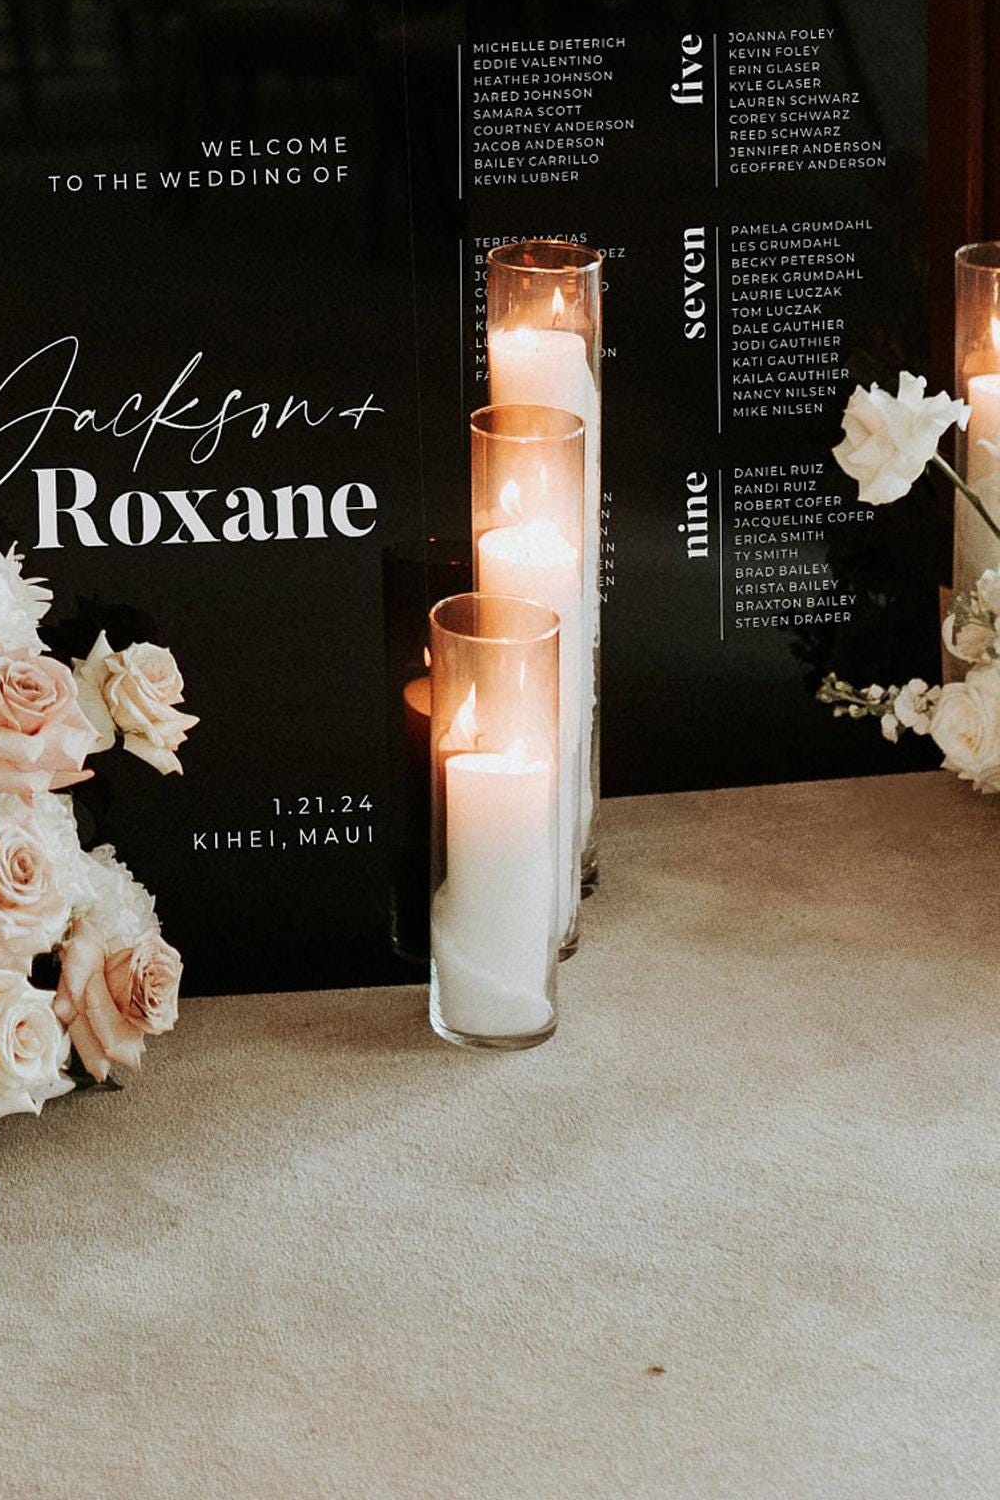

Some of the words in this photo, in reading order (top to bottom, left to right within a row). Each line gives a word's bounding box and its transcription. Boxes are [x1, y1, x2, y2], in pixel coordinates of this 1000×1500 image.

[473, 40, 545, 53] MICHELLE
[549, 37, 625, 51] DIETERICH
[473, 58, 517, 70] EDDIE
[521, 55, 603, 68] VALENTINO
[671, 34, 703, 104] five
[474, 74, 540, 86] HEATHER
[544, 71, 613, 84] JOHNSON
[473, 91, 520, 103] JARED
[523, 88, 592, 101] JOHNSON
[473, 107, 533, 120] SAMARA
[537, 104, 582, 117] SCOTT
[473, 123, 551, 136] COURTNEY
[554, 117, 634, 132] ANDERSON
[202, 137, 346, 157] WELCOME
[473, 140, 520, 153] JACOB
[525, 136, 604, 150] ANDERSON
[474, 157, 525, 170] BAILEY
[528, 153, 599, 167] CARRILLO
[48, 175, 82, 192] TO
[94, 173, 147, 190] THE
[160, 168, 300, 188] WEDDING
[314, 166, 347, 182] OF
[474, 174, 517, 185] KEVIN
[521, 171, 579, 184] LUBNER
[684, 227, 706, 339] seven
[734, 465, 787, 479] DANIEL
[790, 463, 824, 475] RUIZ
[734, 483, 779, 495] RANDI
[784, 480, 816, 492] RUIZ
[32, 468, 377, 549] Roxane
[734, 498, 791, 512] ROBERT
[795, 495, 842, 508] COFER
[678, 472, 708, 559] nine
[734, 513, 823, 528] JACQUELINE
[827, 510, 874, 523] COFER
[735, 533, 777, 545] ERICA
[781, 530, 824, 543] SMITH
[734, 551, 750, 561] TY
[755, 548, 798, 560] SMITH
[735, 566, 775, 579] BRAD
[779, 563, 829, 576] BAILEY
[735, 582, 785, 595] KRISTA
[789, 579, 839, 592] BAILEY
[736, 598, 802, 612] BRAXTON
[806, 595, 857, 608] BAILEY
[735, 616, 789, 628] STEVEN
[794, 612, 851, 625] DRAPER
[274, 795, 372, 815] 1.21.24
[194, 830, 286, 850] KIHEI,
[300, 826, 372, 845] MAUI
